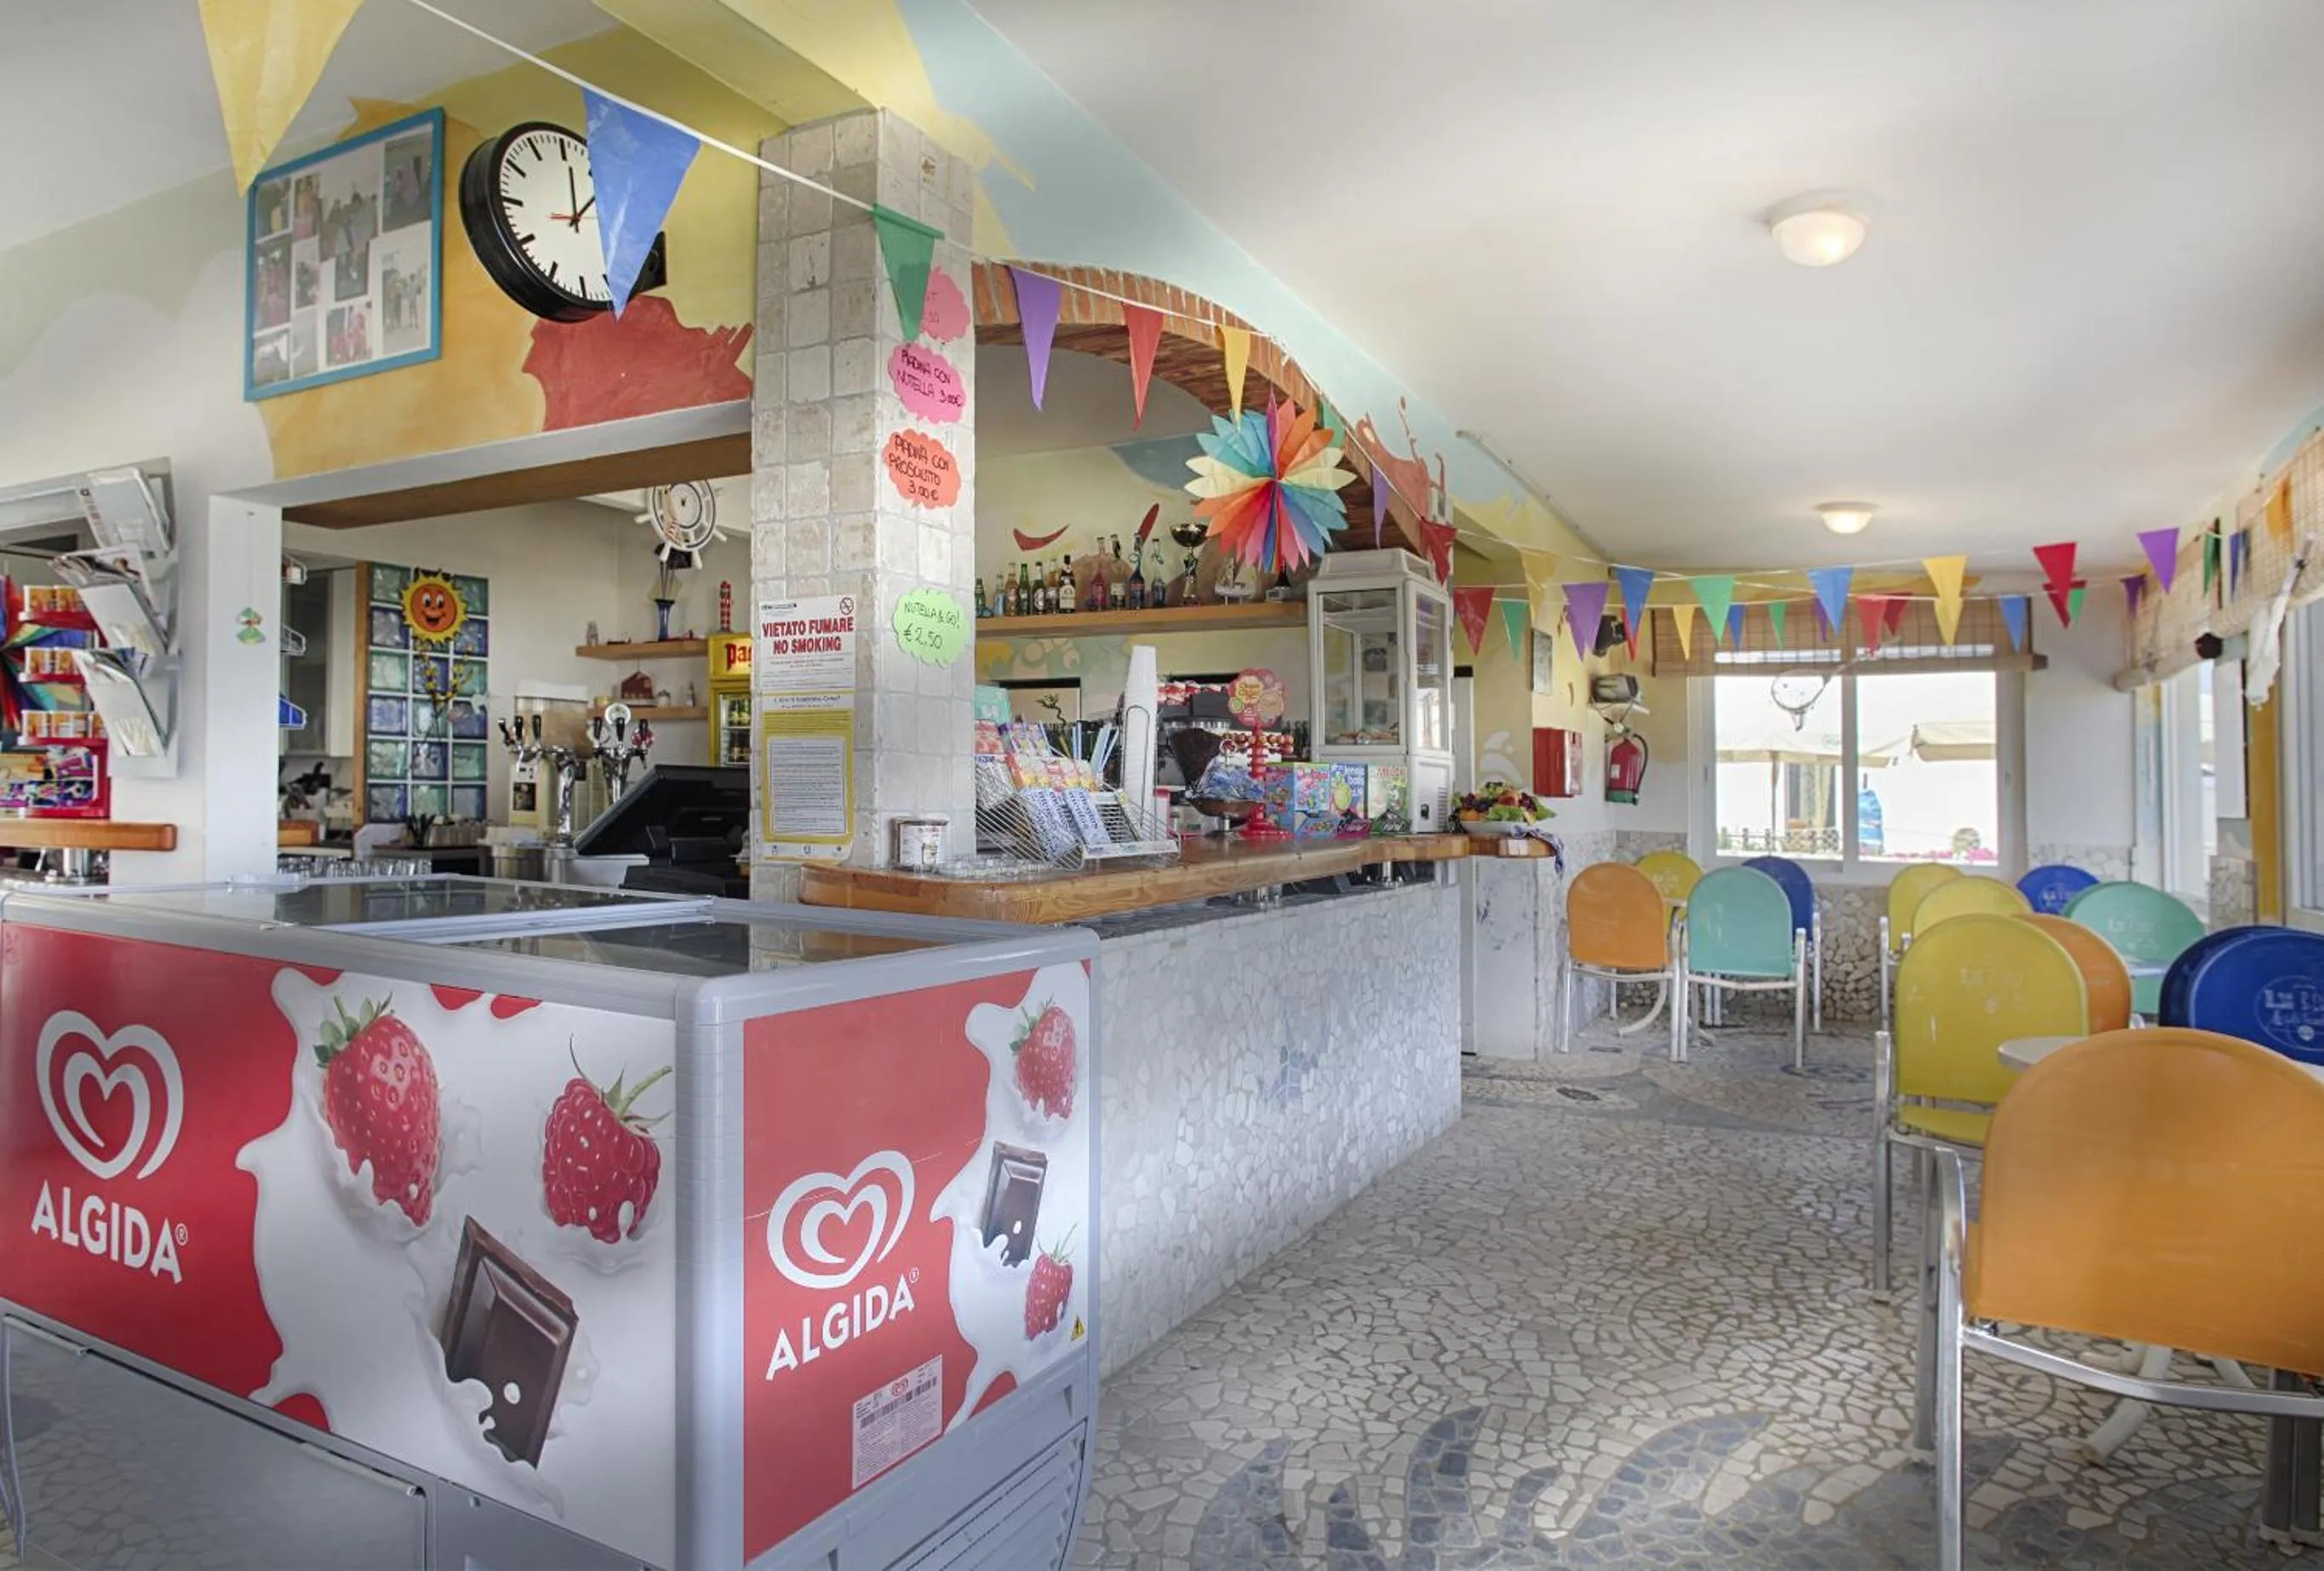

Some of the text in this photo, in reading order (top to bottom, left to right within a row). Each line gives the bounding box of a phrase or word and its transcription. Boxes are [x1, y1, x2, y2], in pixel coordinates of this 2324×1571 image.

[896, 370, 935, 398] NUTELLA
[934, 368, 951, 384] CON
[932, 454, 948, 471] CON
[762, 616, 854, 637] VIETATO FUMARE
[773, 636, 841, 654] NO SMOKING
[31, 1178, 183, 1285] ALGIDA
[765, 1273, 915, 1381] ALGIDA
